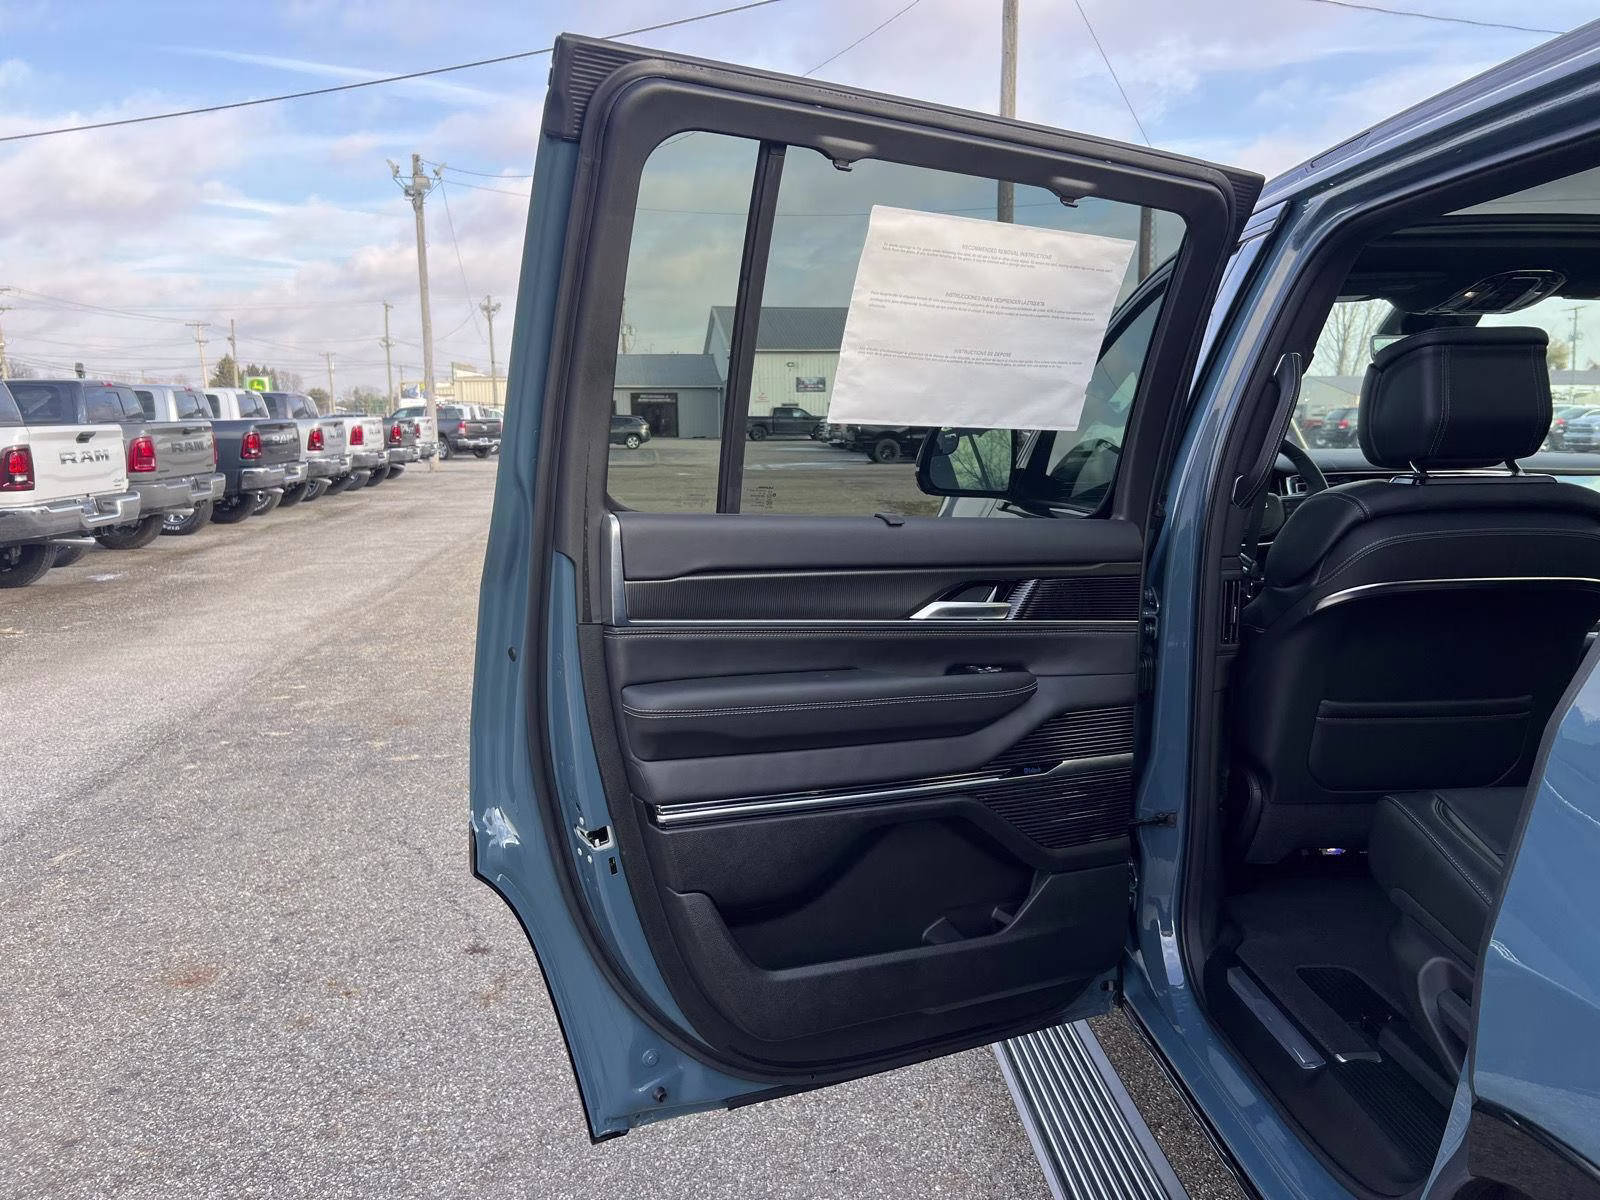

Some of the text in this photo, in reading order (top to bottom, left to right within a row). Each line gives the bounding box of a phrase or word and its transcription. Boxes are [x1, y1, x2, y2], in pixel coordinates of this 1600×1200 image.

[962, 244, 997, 254] RECOMMENDED
[998, 248, 1019, 256] REMOVAL
[1020, 251, 1052, 260] INSTRUCTIONS
[171, 441, 206, 453] RAM
[59, 449, 109, 465] RAM
